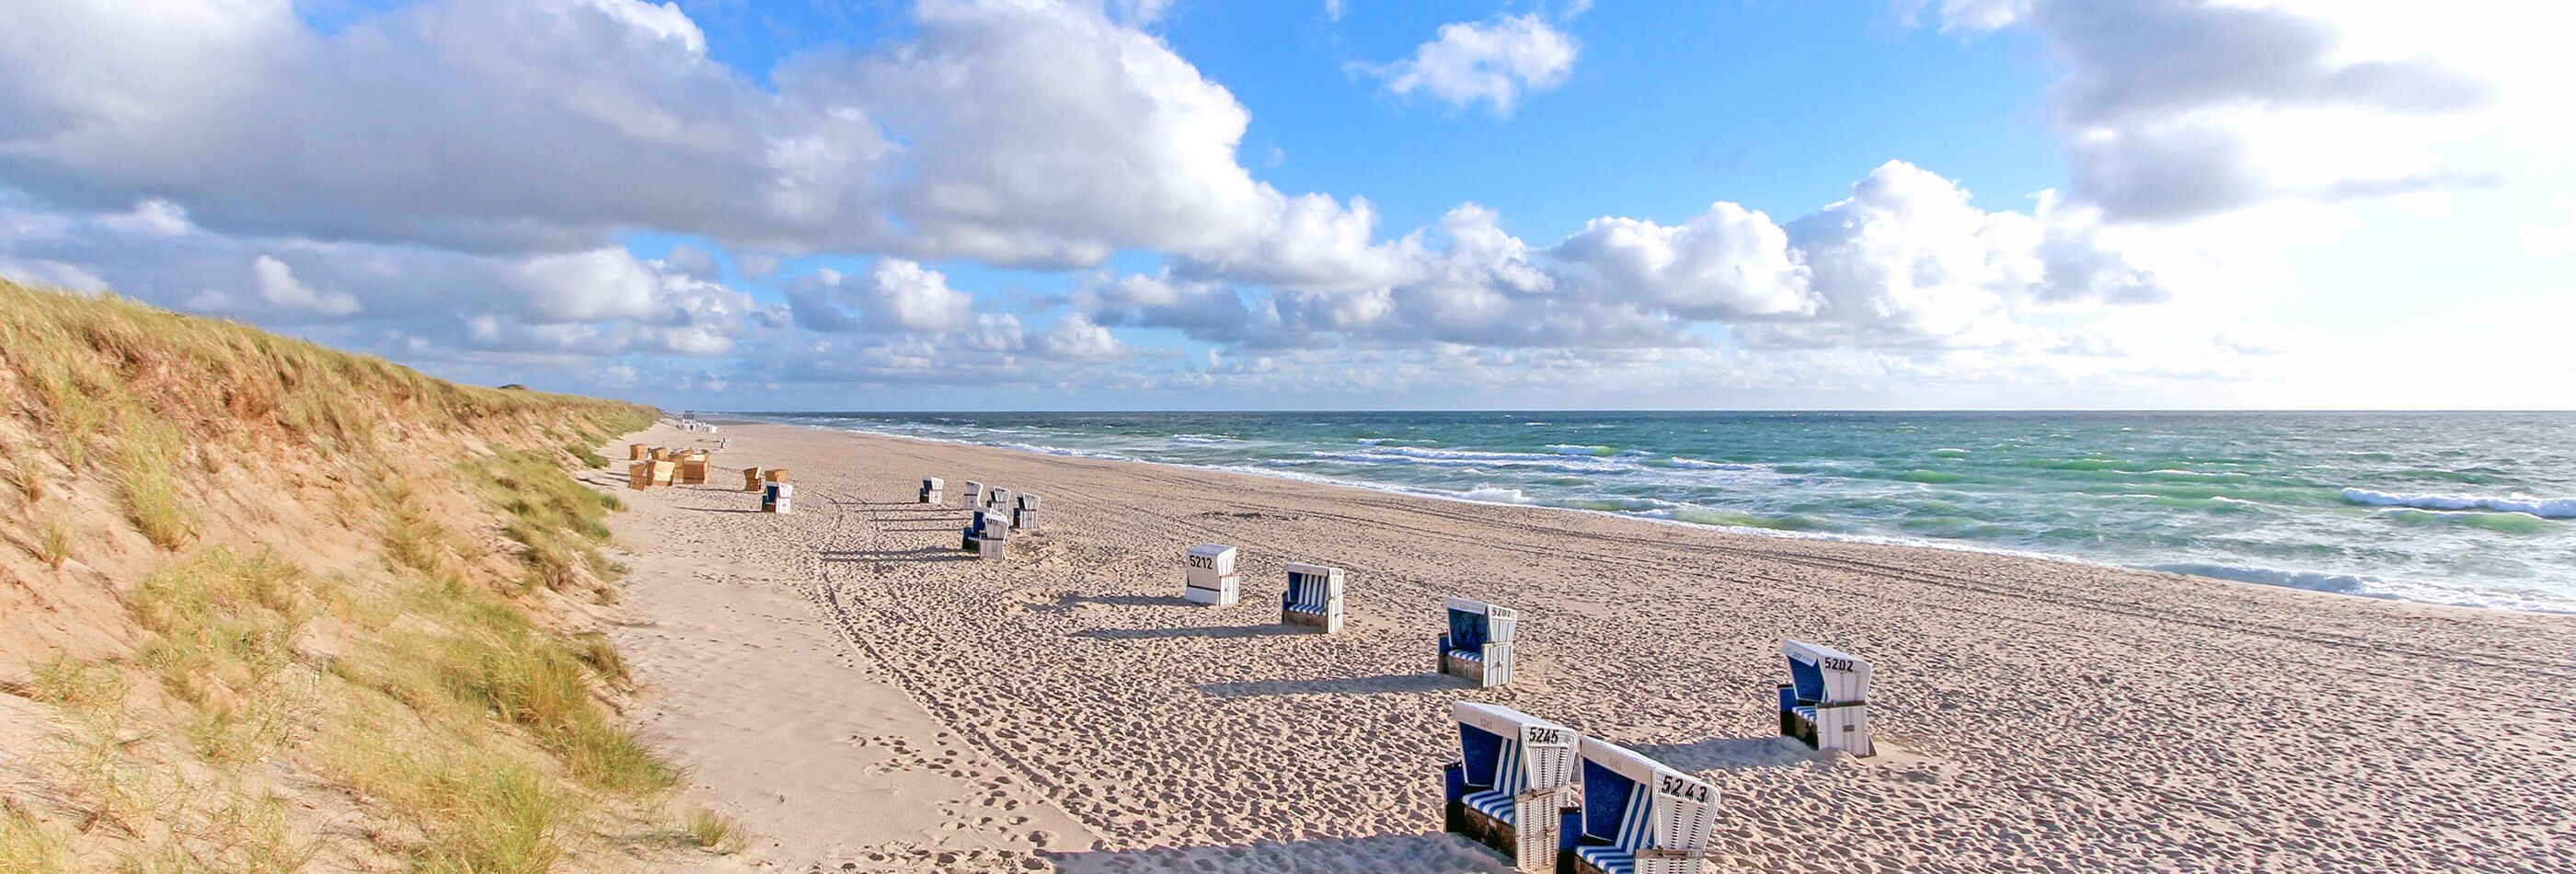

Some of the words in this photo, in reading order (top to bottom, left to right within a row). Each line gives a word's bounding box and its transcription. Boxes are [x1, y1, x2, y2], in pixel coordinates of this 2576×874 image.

[1190, 555, 1213, 569] 5212
[1824, 657, 1853, 672] 5202
[1528, 727, 1558, 744] 5245
[1662, 775, 1708, 802] 5243
